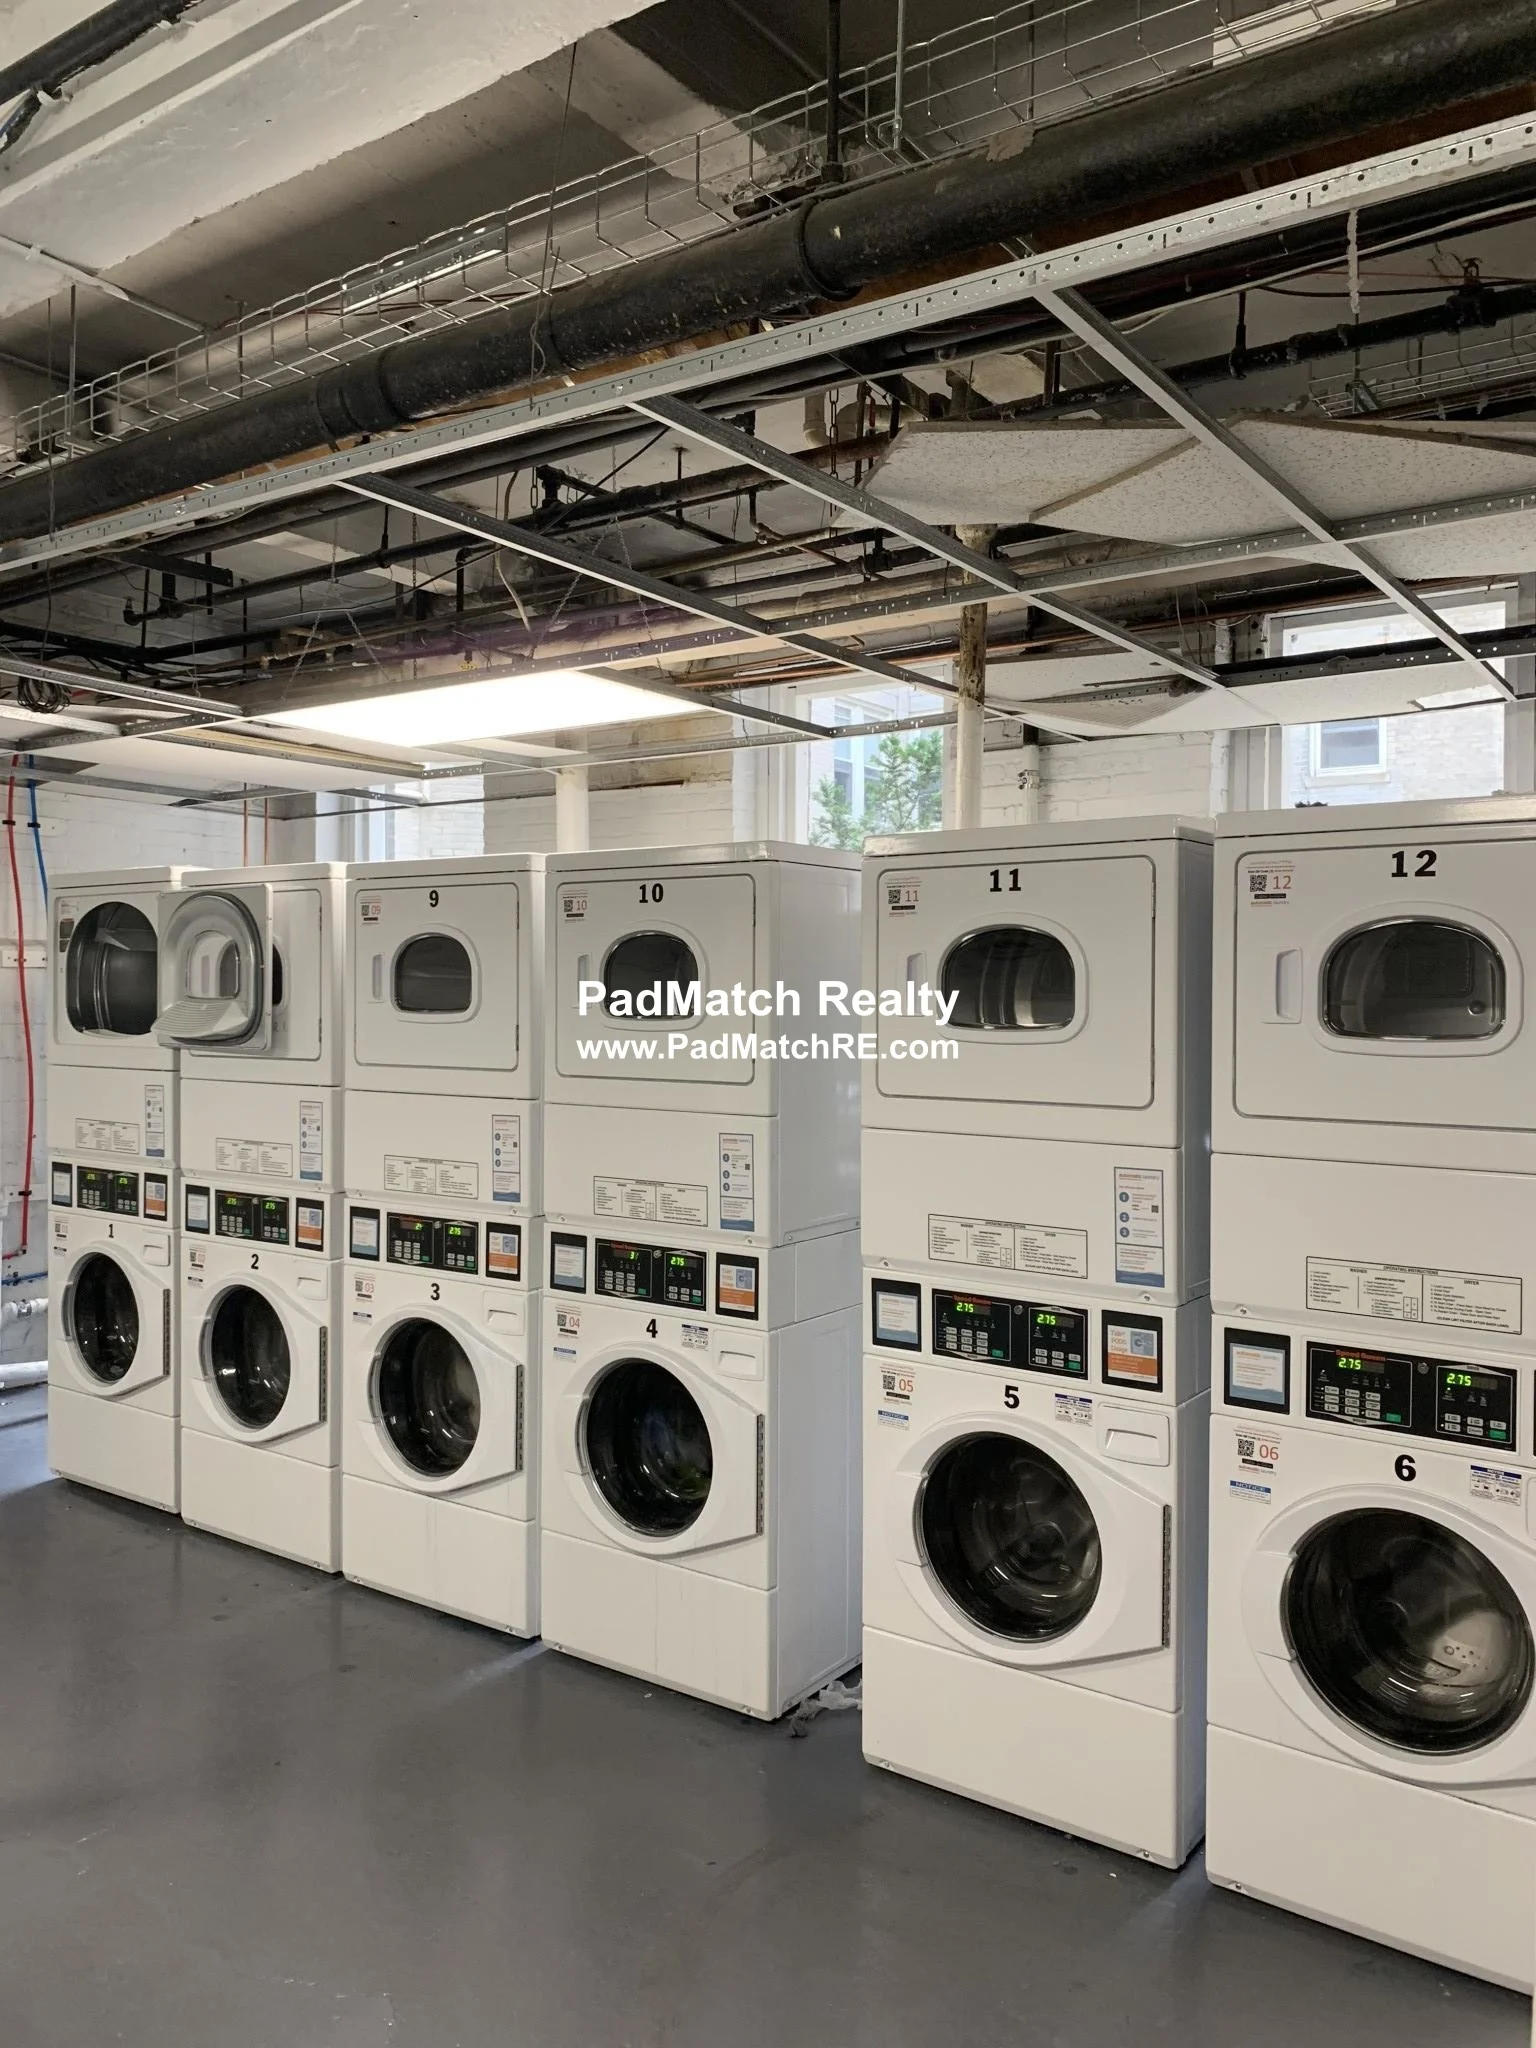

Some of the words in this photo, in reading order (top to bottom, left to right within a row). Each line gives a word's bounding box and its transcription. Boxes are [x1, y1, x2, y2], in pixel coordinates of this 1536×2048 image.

[1390, 850, 1438, 878] 12
[989, 868, 1022, 893] 11
[1272, 875, 1292, 890] 12
[429, 889, 440, 908] 9
[638, 883, 664, 903] 10
[905, 890, 919, 902] 11
[576, 900, 588, 911] 10
[108, 1223, 114, 1239] 1
[251, 1253, 260, 1270] 2
[430, 1282, 440, 1301] 3
[646, 1318, 658, 1338] 4
[1338, 1357, 1362, 1370] 2.75
[899, 1378, 914, 1393] 05
[1446, 1373, 1472, 1387] 2.75
[1004, 1385, 1020, 1409] 5
[1259, 1444, 1279, 1461] 06
[1394, 1454, 1417, 1482] 6
